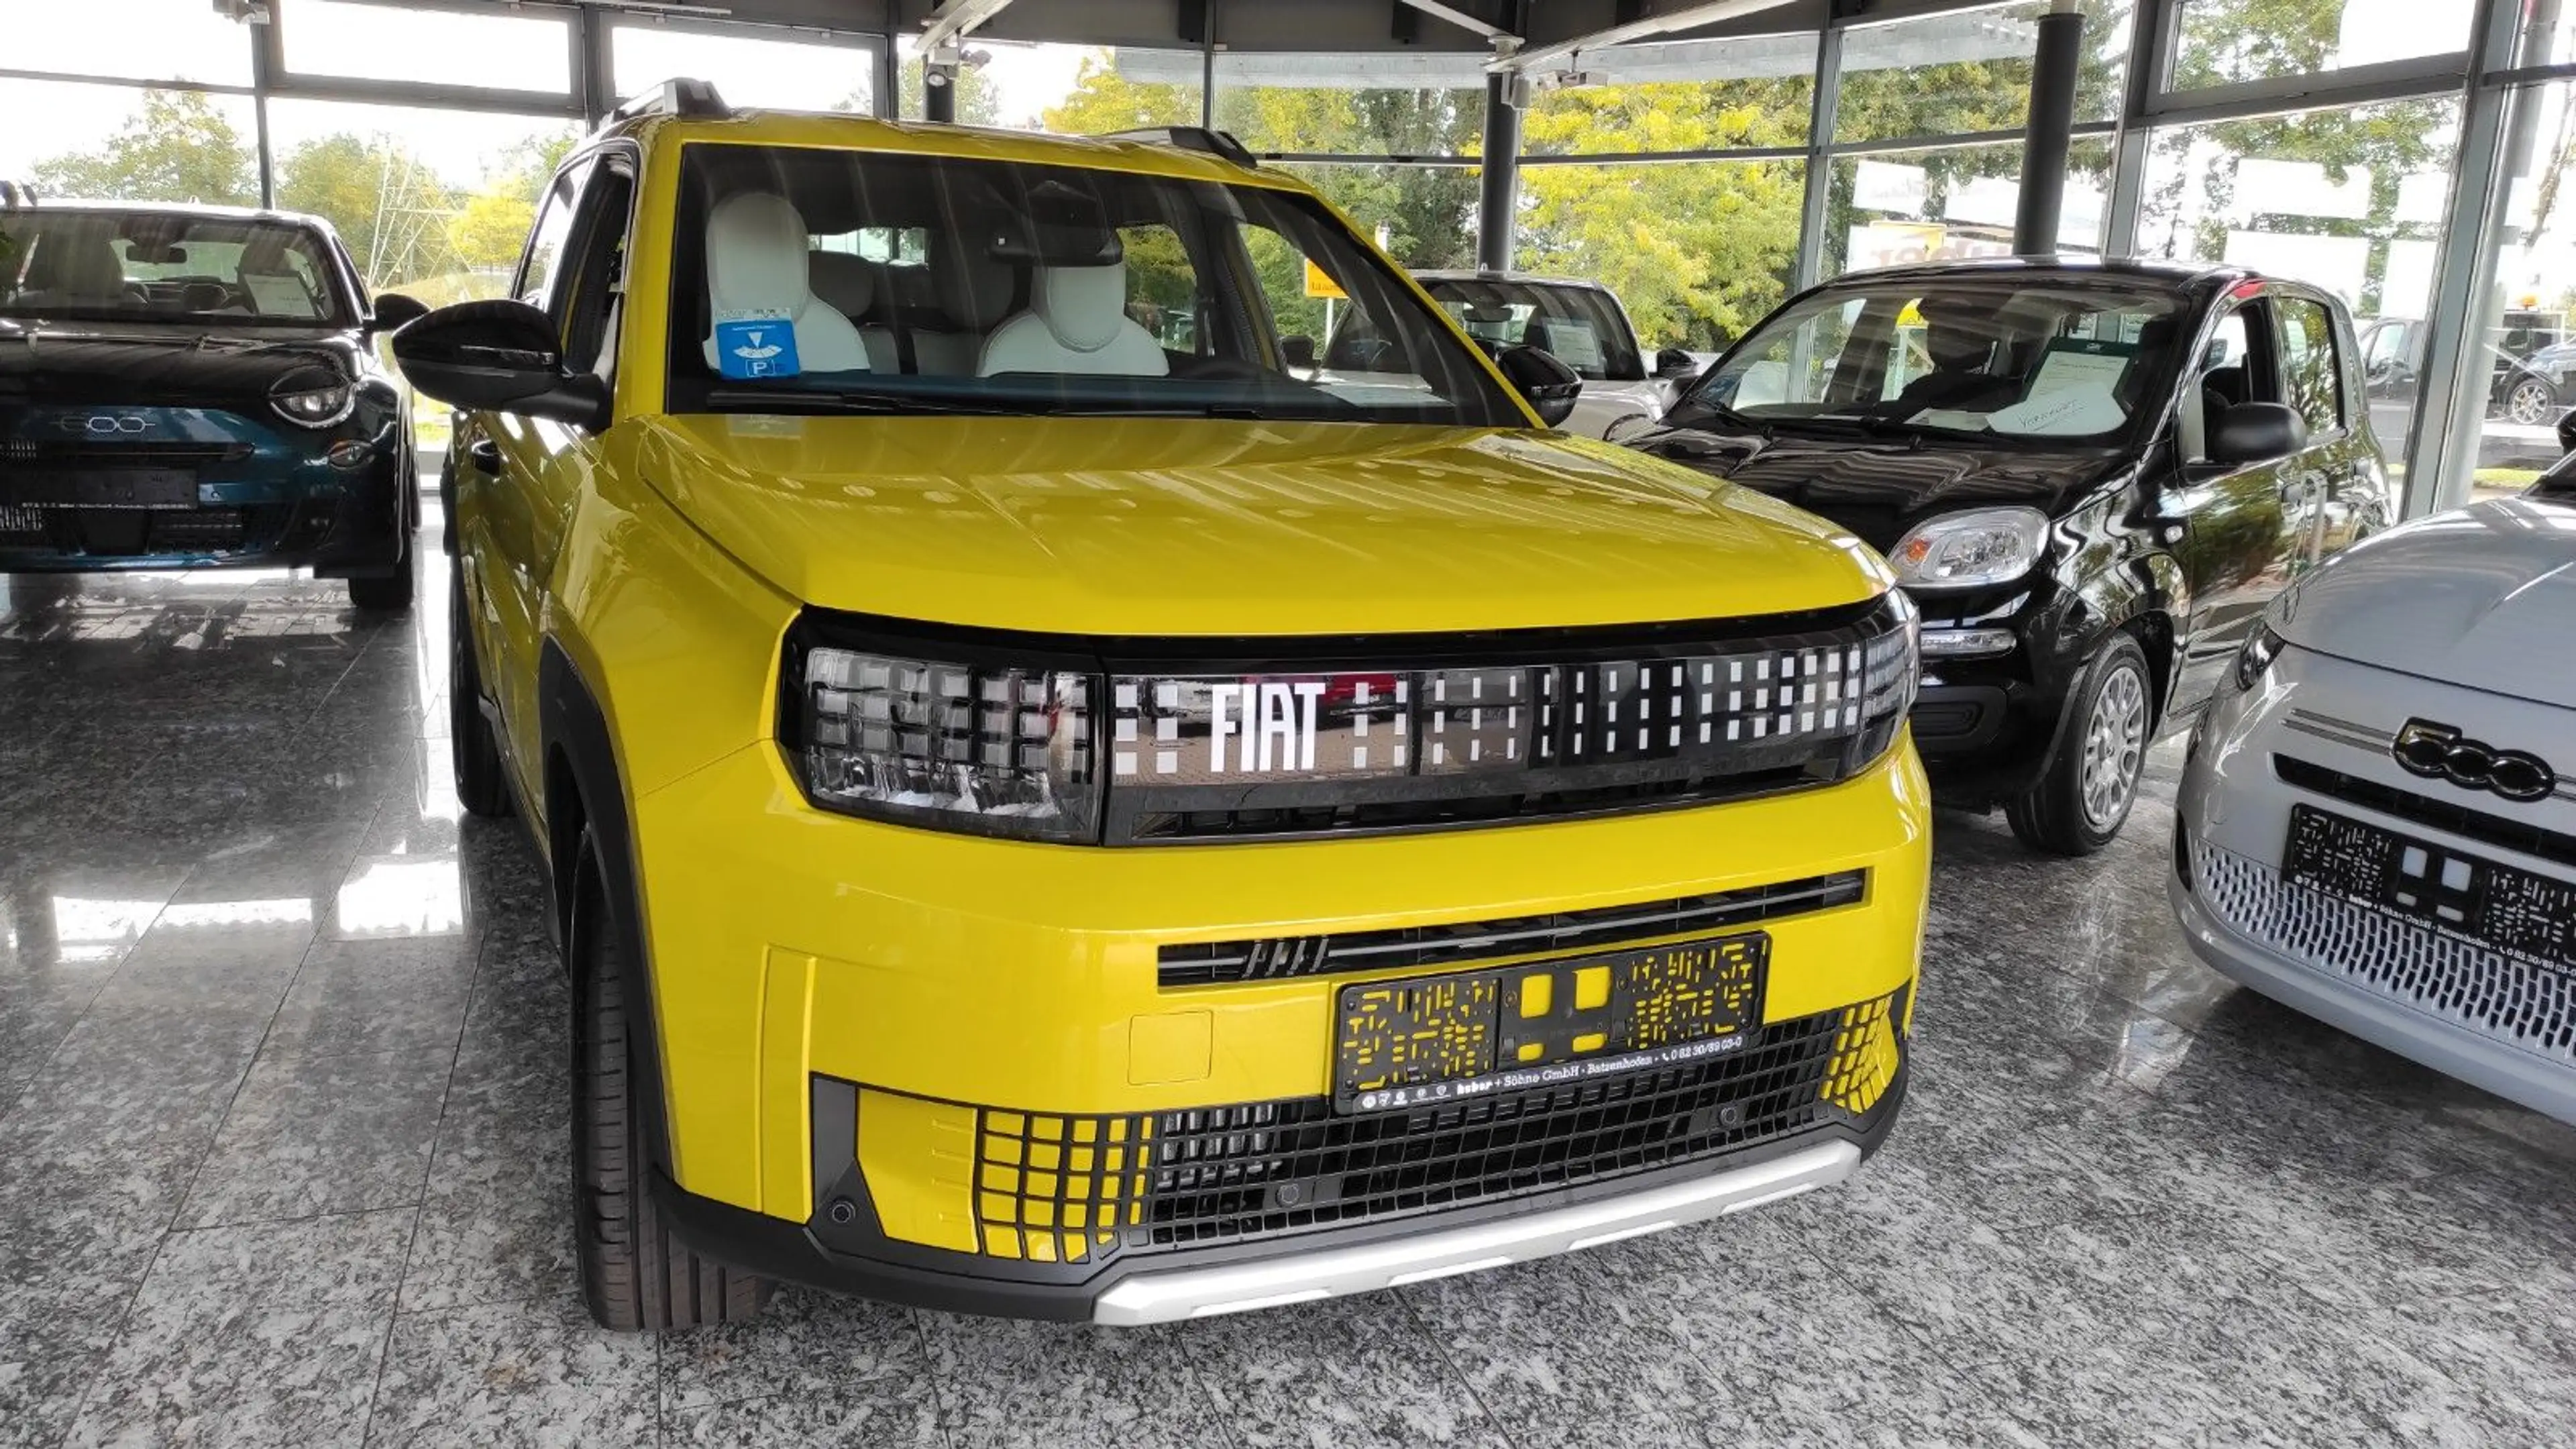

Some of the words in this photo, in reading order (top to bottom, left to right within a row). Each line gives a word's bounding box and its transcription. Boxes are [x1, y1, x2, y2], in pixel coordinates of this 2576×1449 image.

[753, 362, 767, 374] P
[1211, 682, 1326, 773] FIAT
[2393, 717, 2555, 802] 500
[1504, 1073, 1541, 1087] Söhne
[1542, 1065, 1580, 1081] GmbH
[1587, 1054, 1654, 1075] Batzenhofen
[1670, 1049, 1678, 1060] 0
[1679, 1046, 1692, 1059] 82
